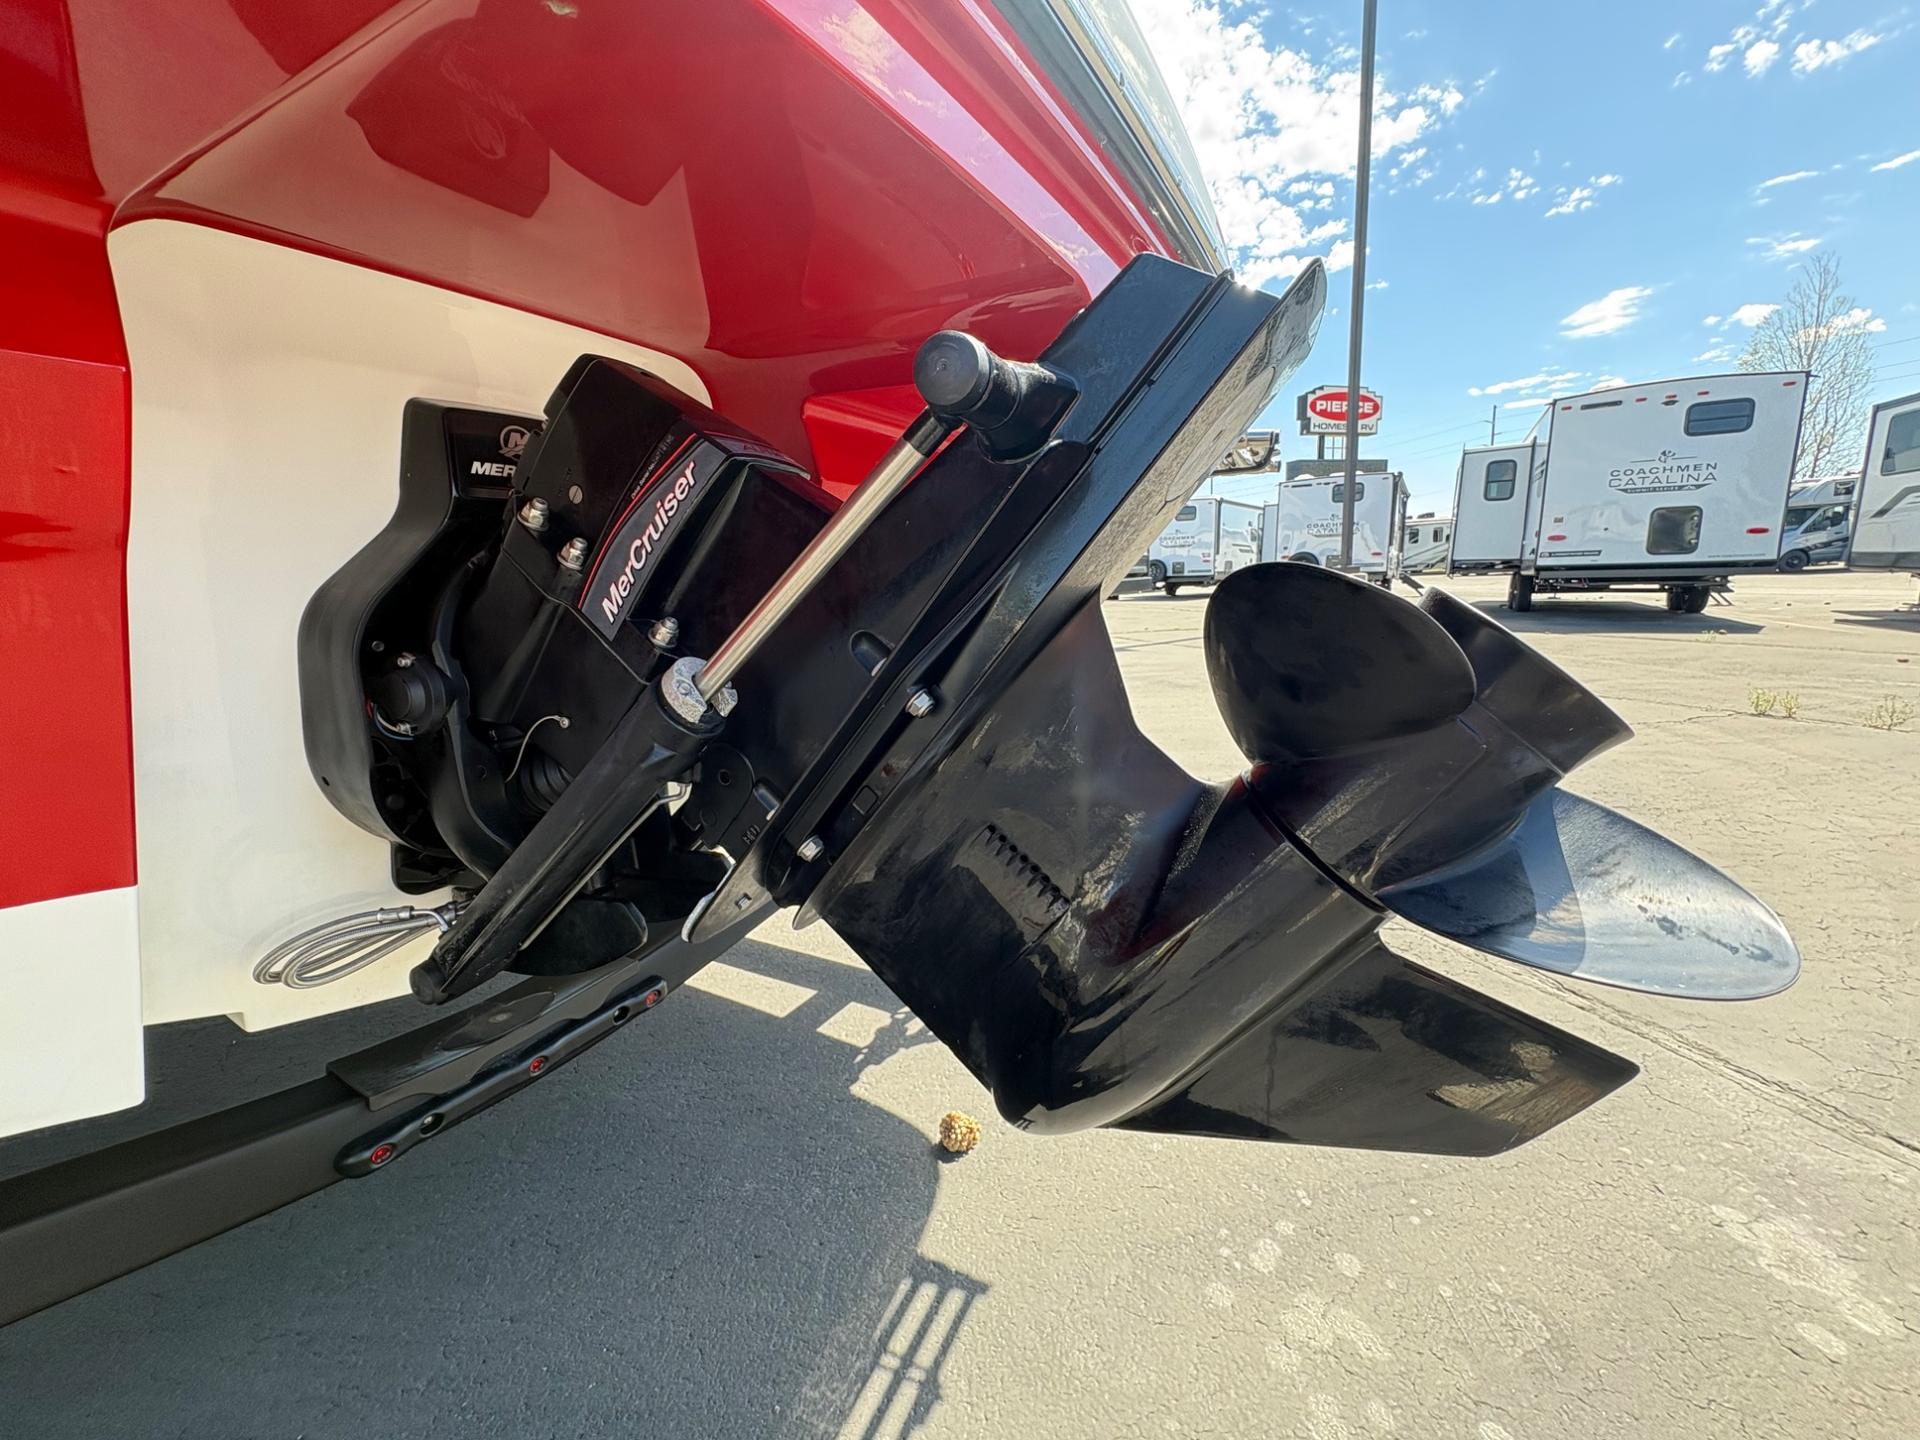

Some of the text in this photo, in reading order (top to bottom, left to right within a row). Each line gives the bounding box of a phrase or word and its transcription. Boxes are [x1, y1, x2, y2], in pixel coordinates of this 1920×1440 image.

[1610, 462, 1718, 477] COACHMEN
[1608, 472, 1718, 488] CATALINA
[601, 460, 697, 624] MerCruiser
